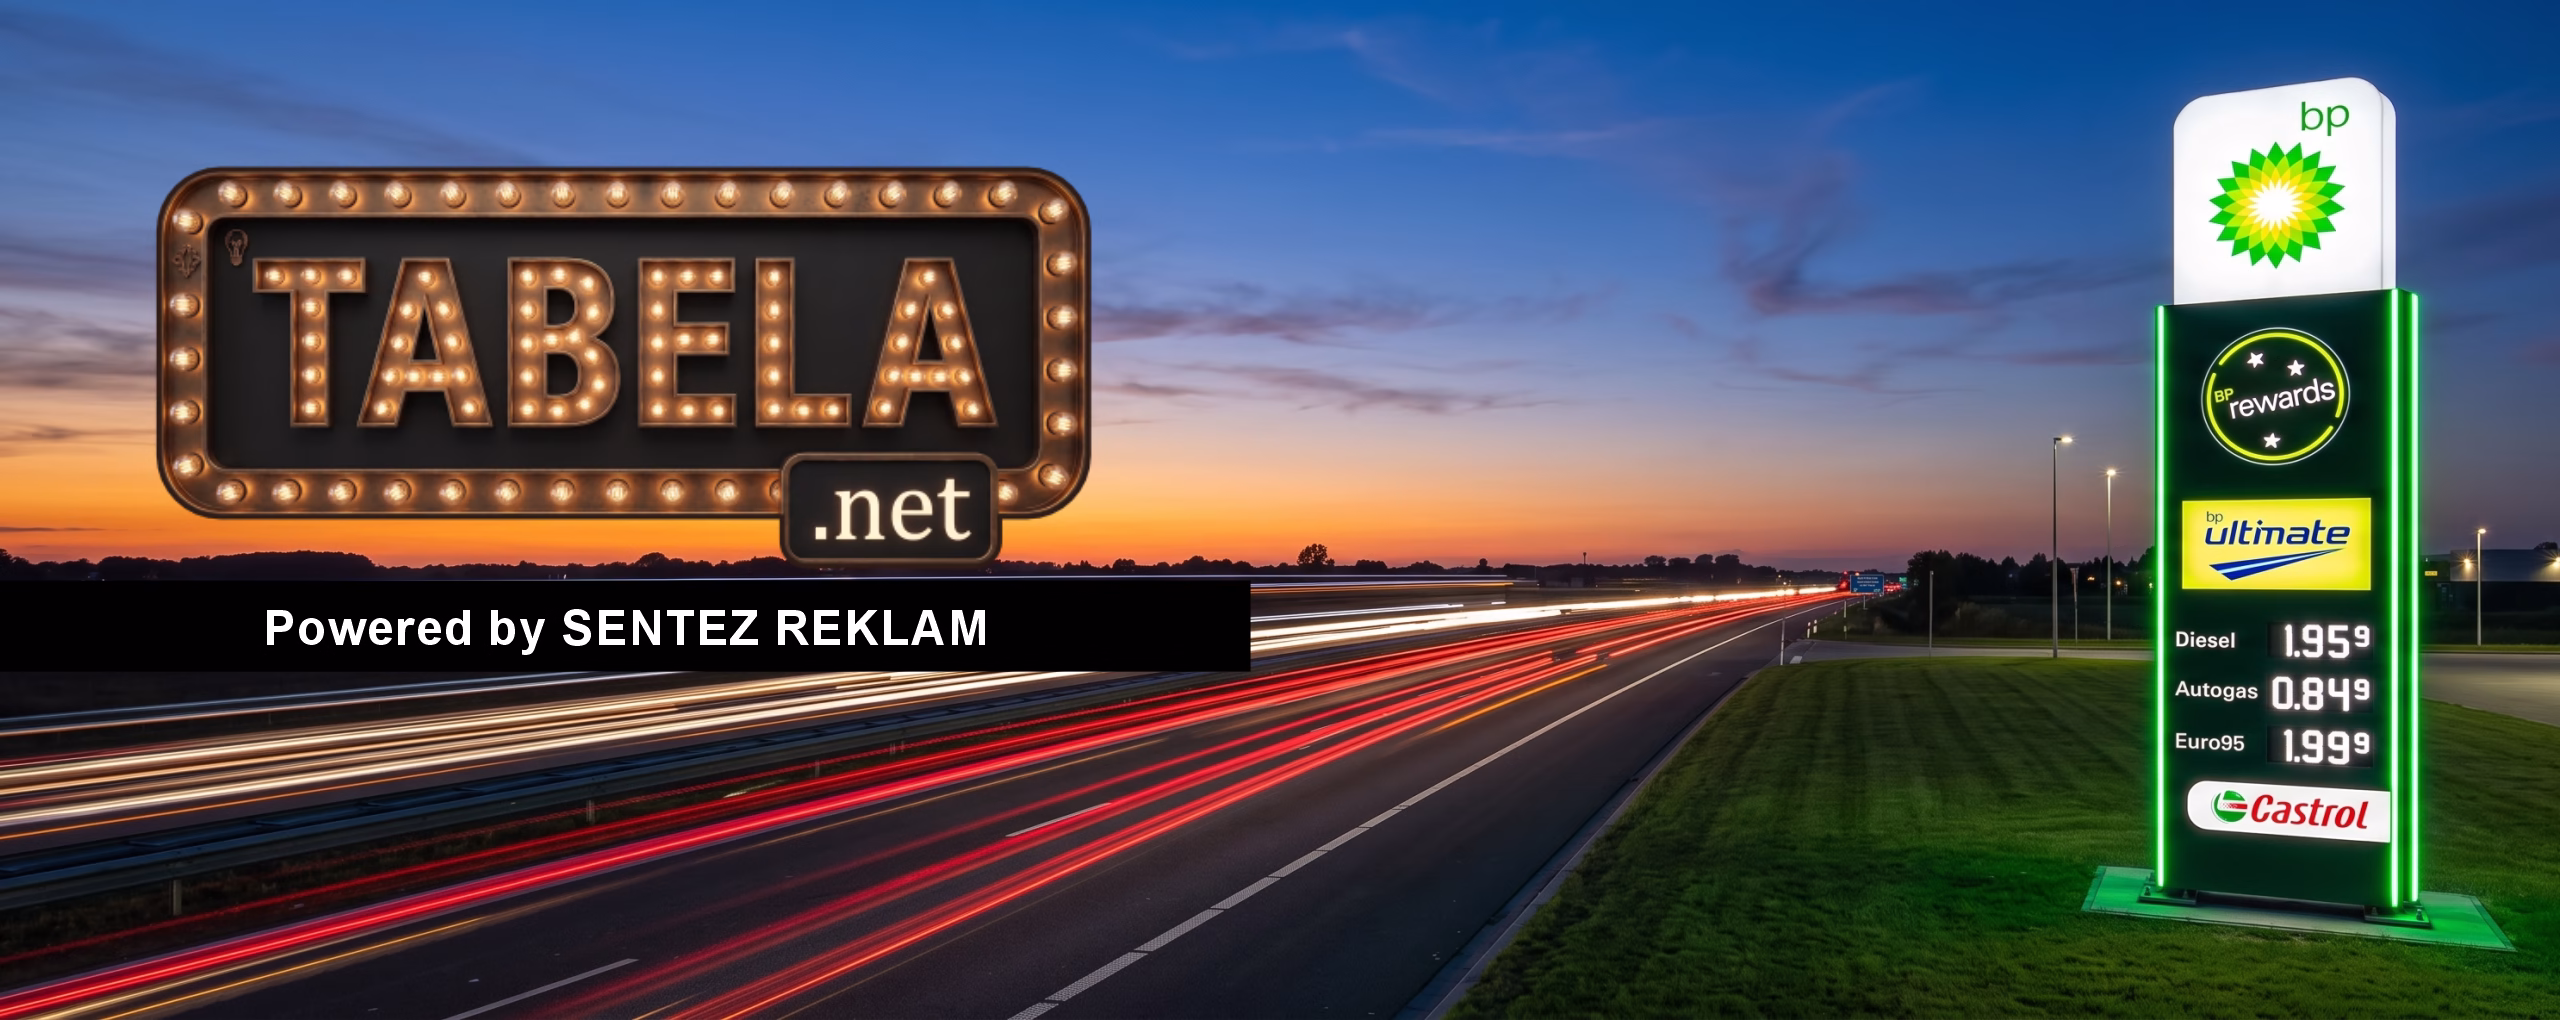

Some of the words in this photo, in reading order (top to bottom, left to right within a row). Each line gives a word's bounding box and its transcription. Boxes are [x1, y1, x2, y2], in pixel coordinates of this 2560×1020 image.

[2301, 101, 2350, 136] bp
[2214, 387, 2234, 403] BP
[2229, 377, 2336, 419] rewards
[2206, 511, 2224, 525] bp
[2205, 519, 2351, 545] ultimate
[2175, 630, 2236, 649] Diesel
[2174, 679, 2259, 701] Autogas
[2175, 732, 2245, 752] Euro95
[2251, 794, 2369, 829] Castrol
